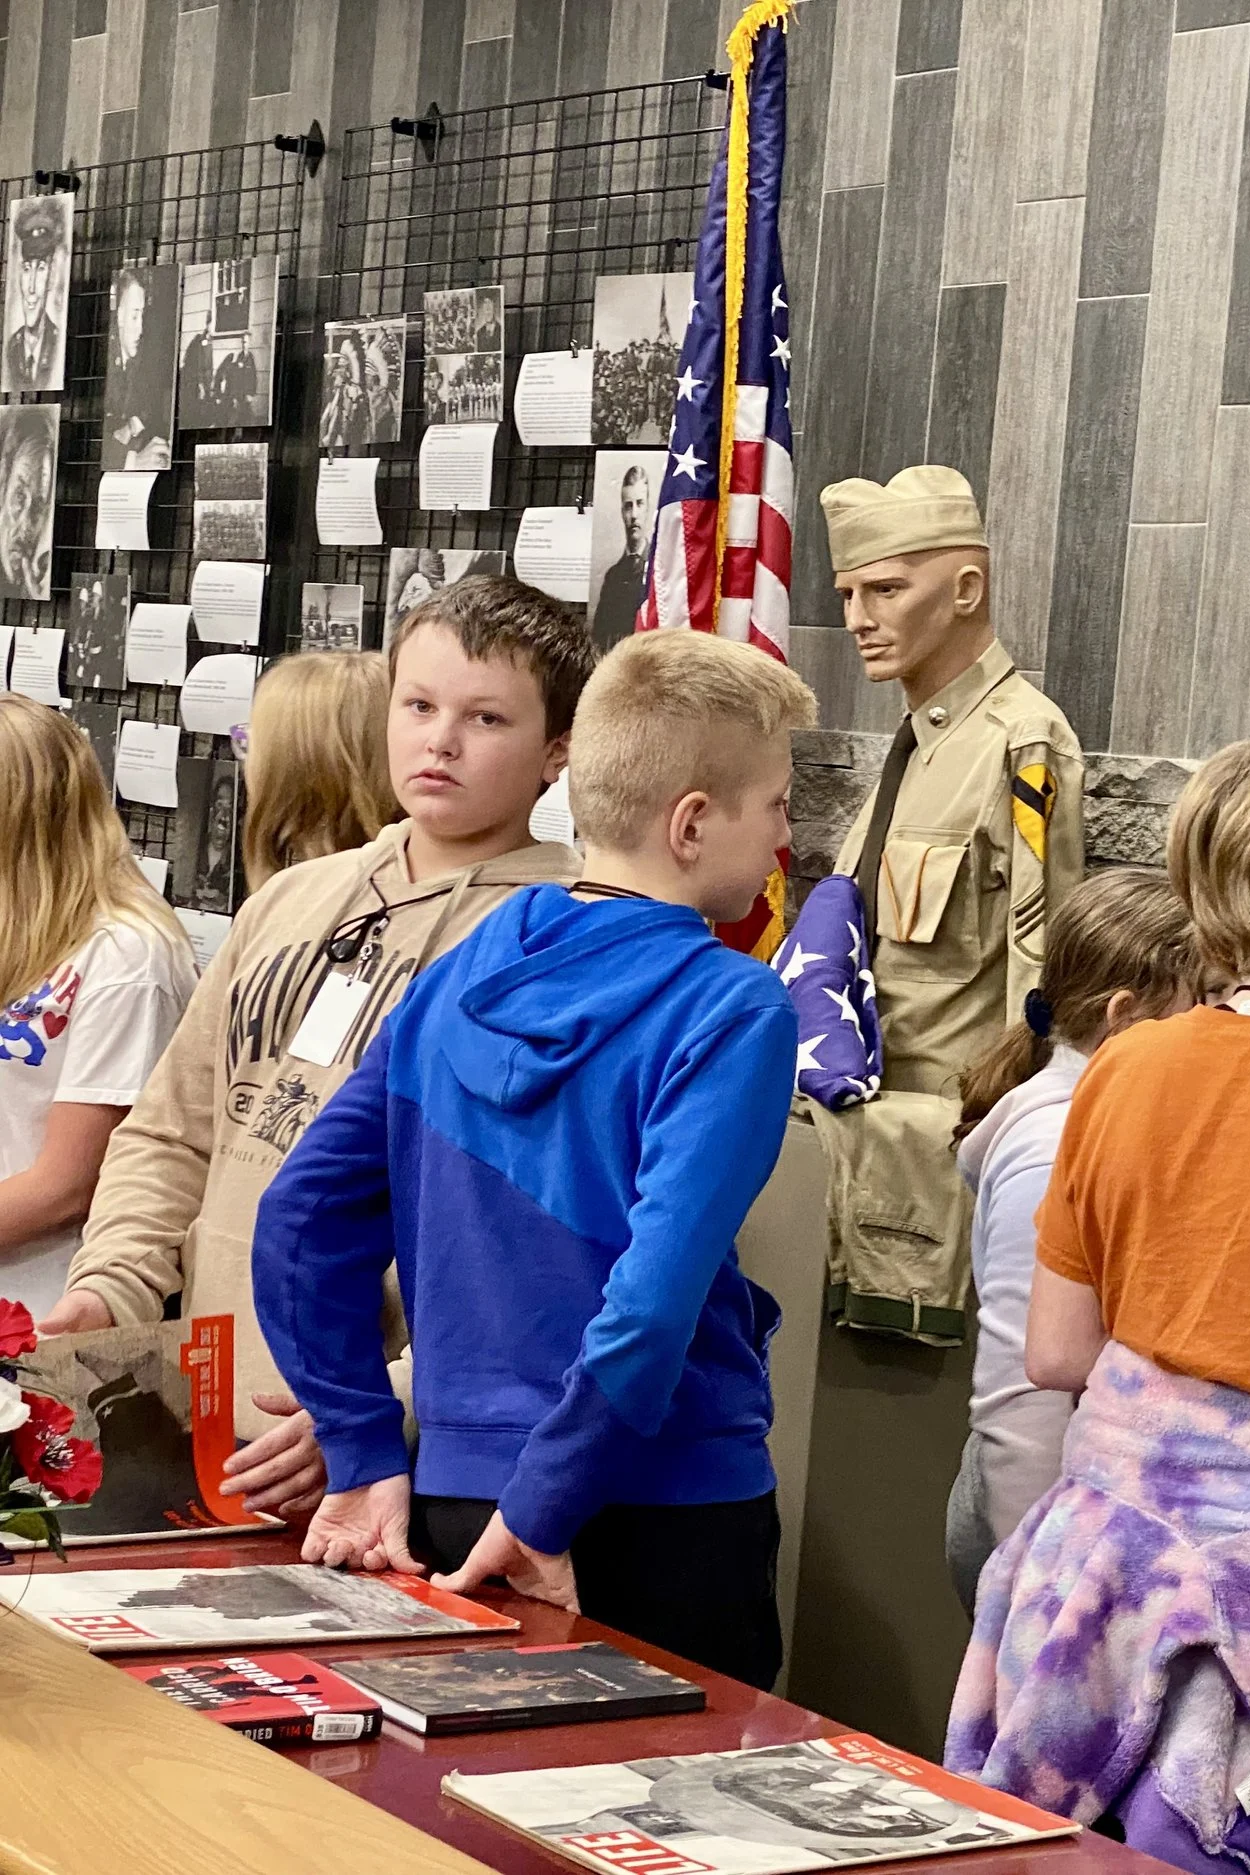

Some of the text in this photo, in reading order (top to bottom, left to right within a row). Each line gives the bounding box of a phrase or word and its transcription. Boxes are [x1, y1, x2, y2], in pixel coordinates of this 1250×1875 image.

[60, 1616, 158, 1641] LIFE
[160, 1667, 235, 1704] CARRIED
[218, 1657, 330, 1716] TIM O'BRIEN
[568, 1832, 708, 1875] LIFE
